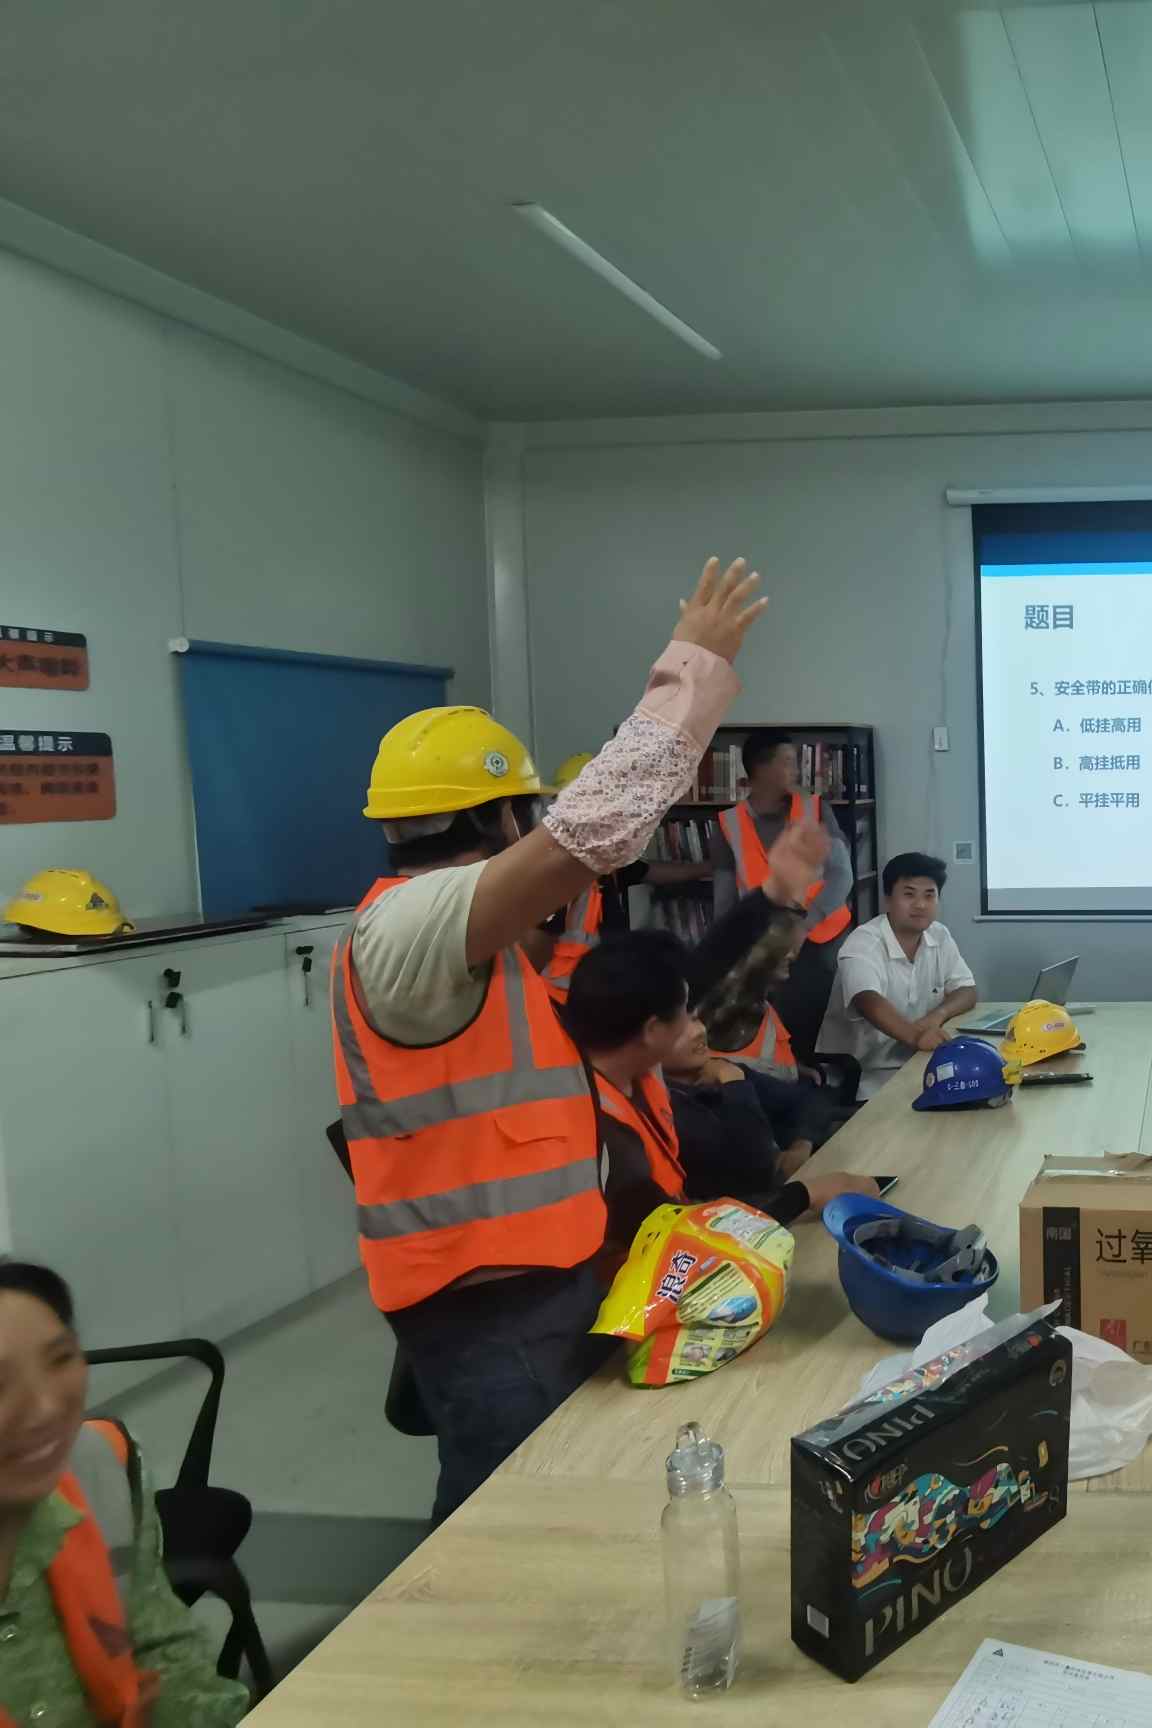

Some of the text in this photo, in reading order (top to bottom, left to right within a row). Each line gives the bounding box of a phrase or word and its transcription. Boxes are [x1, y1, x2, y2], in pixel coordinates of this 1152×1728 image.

[1024, 604, 1074, 630] 题目
[656, 1250, 697, 1303] 浪奇
[843, 1402, 936, 1462] PINO
